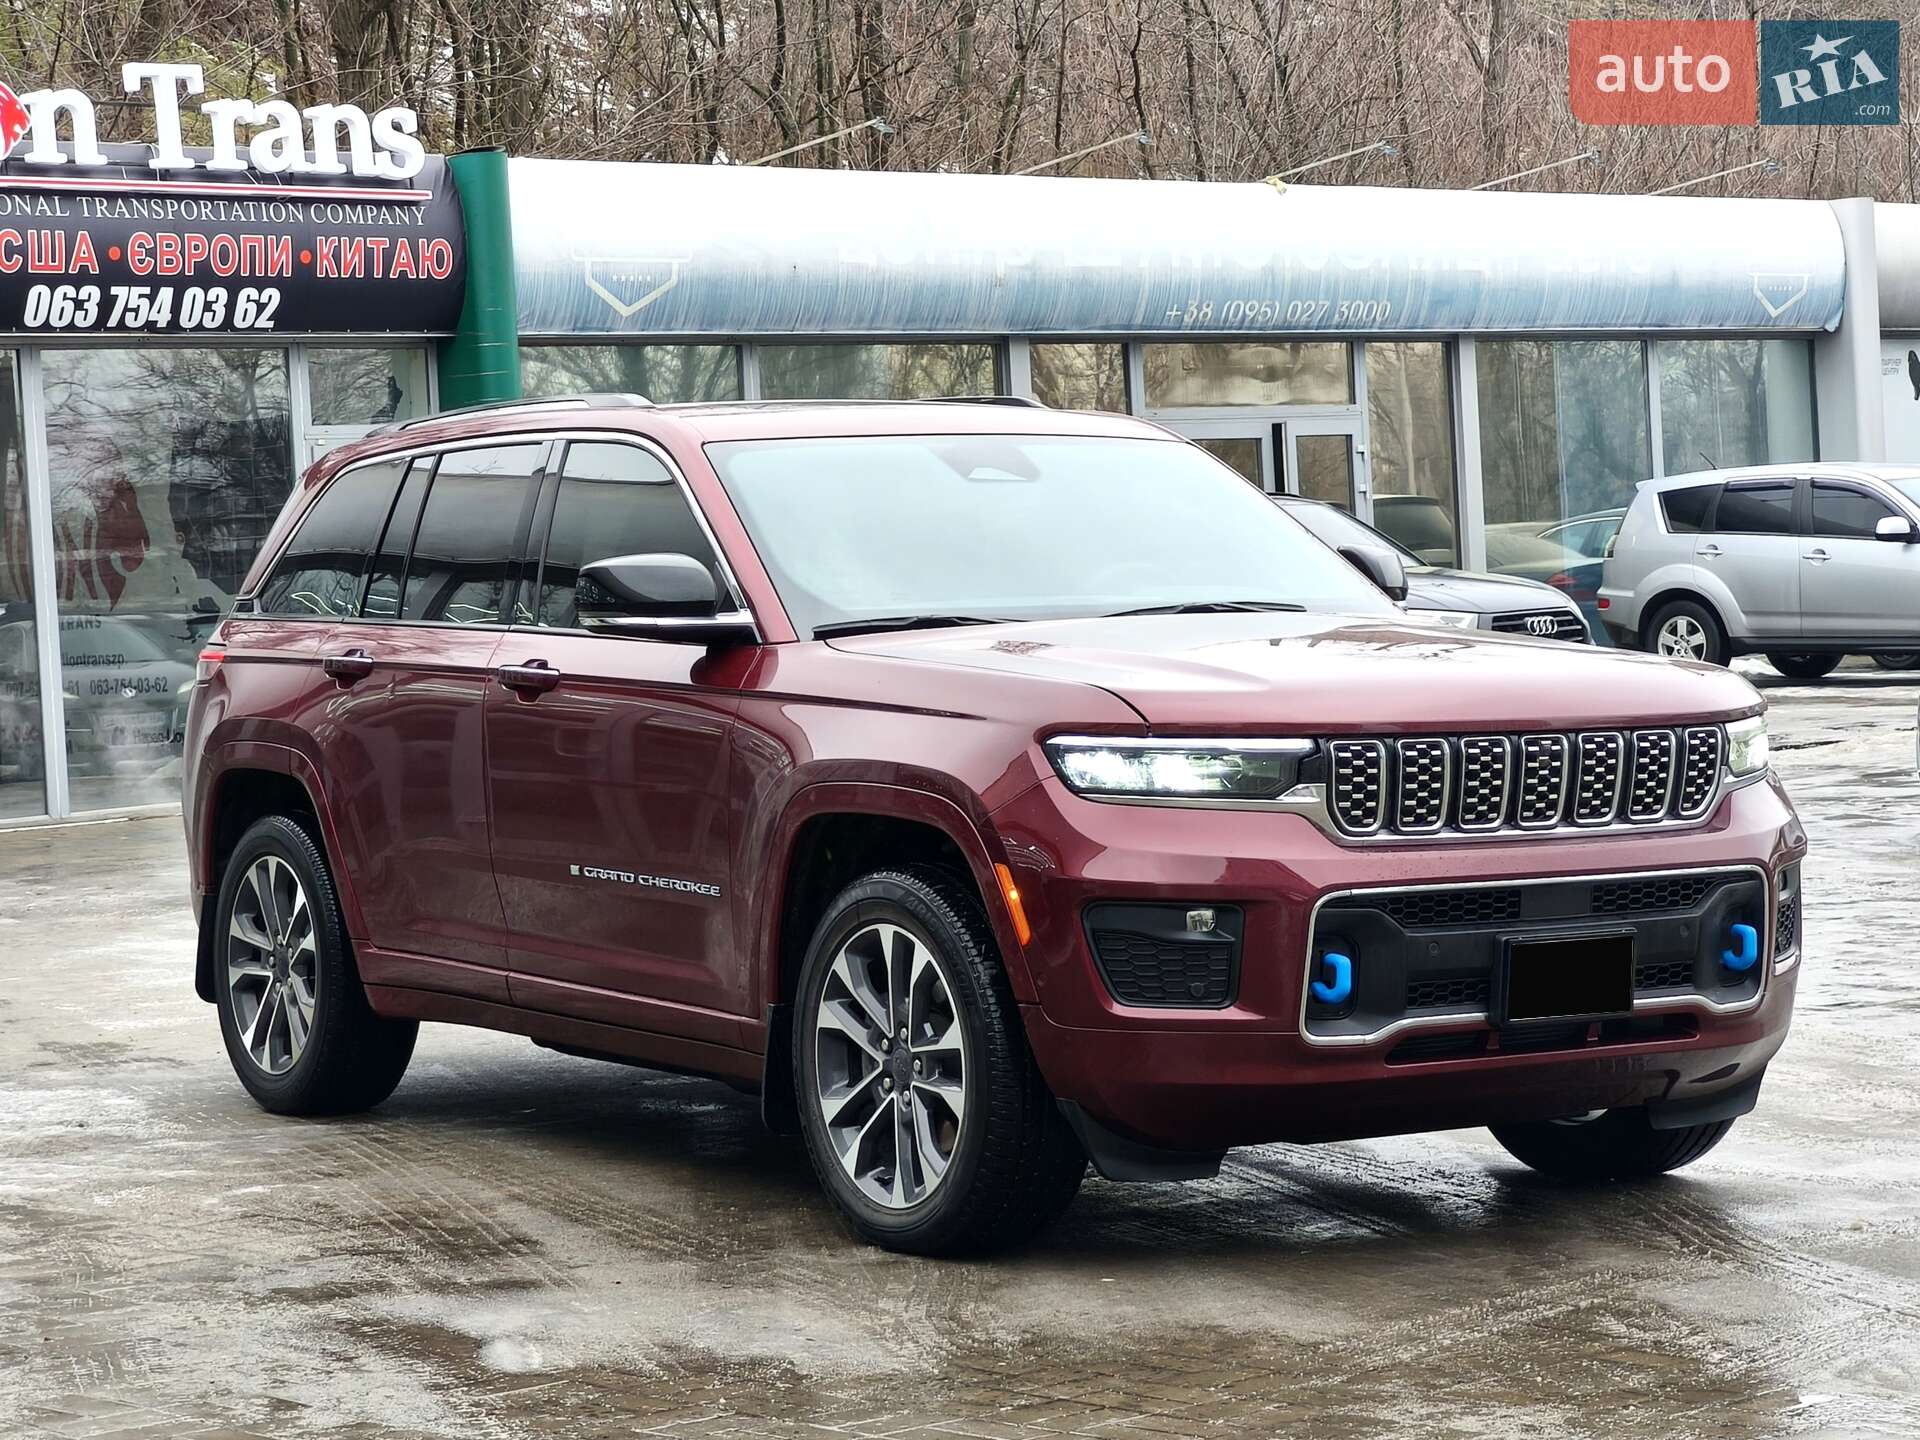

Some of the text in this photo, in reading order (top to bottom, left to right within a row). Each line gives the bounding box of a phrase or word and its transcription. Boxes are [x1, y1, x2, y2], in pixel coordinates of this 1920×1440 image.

[122, 62, 426, 180] Trans
[0, 194, 427, 226] ONAL TRANSPORTATION COMPANY
[0, 228, 454, 280] США ЄВРОПИ КИТАЮ
[23, 284, 281, 329] 063 754 03 62
[1222, 299, 1280, 325] (095)
[1286, 300, 1330, 323] 027
[1334, 300, 1393, 323] 3000
[583, 866, 721, 897] GRAND CHEROKEE
